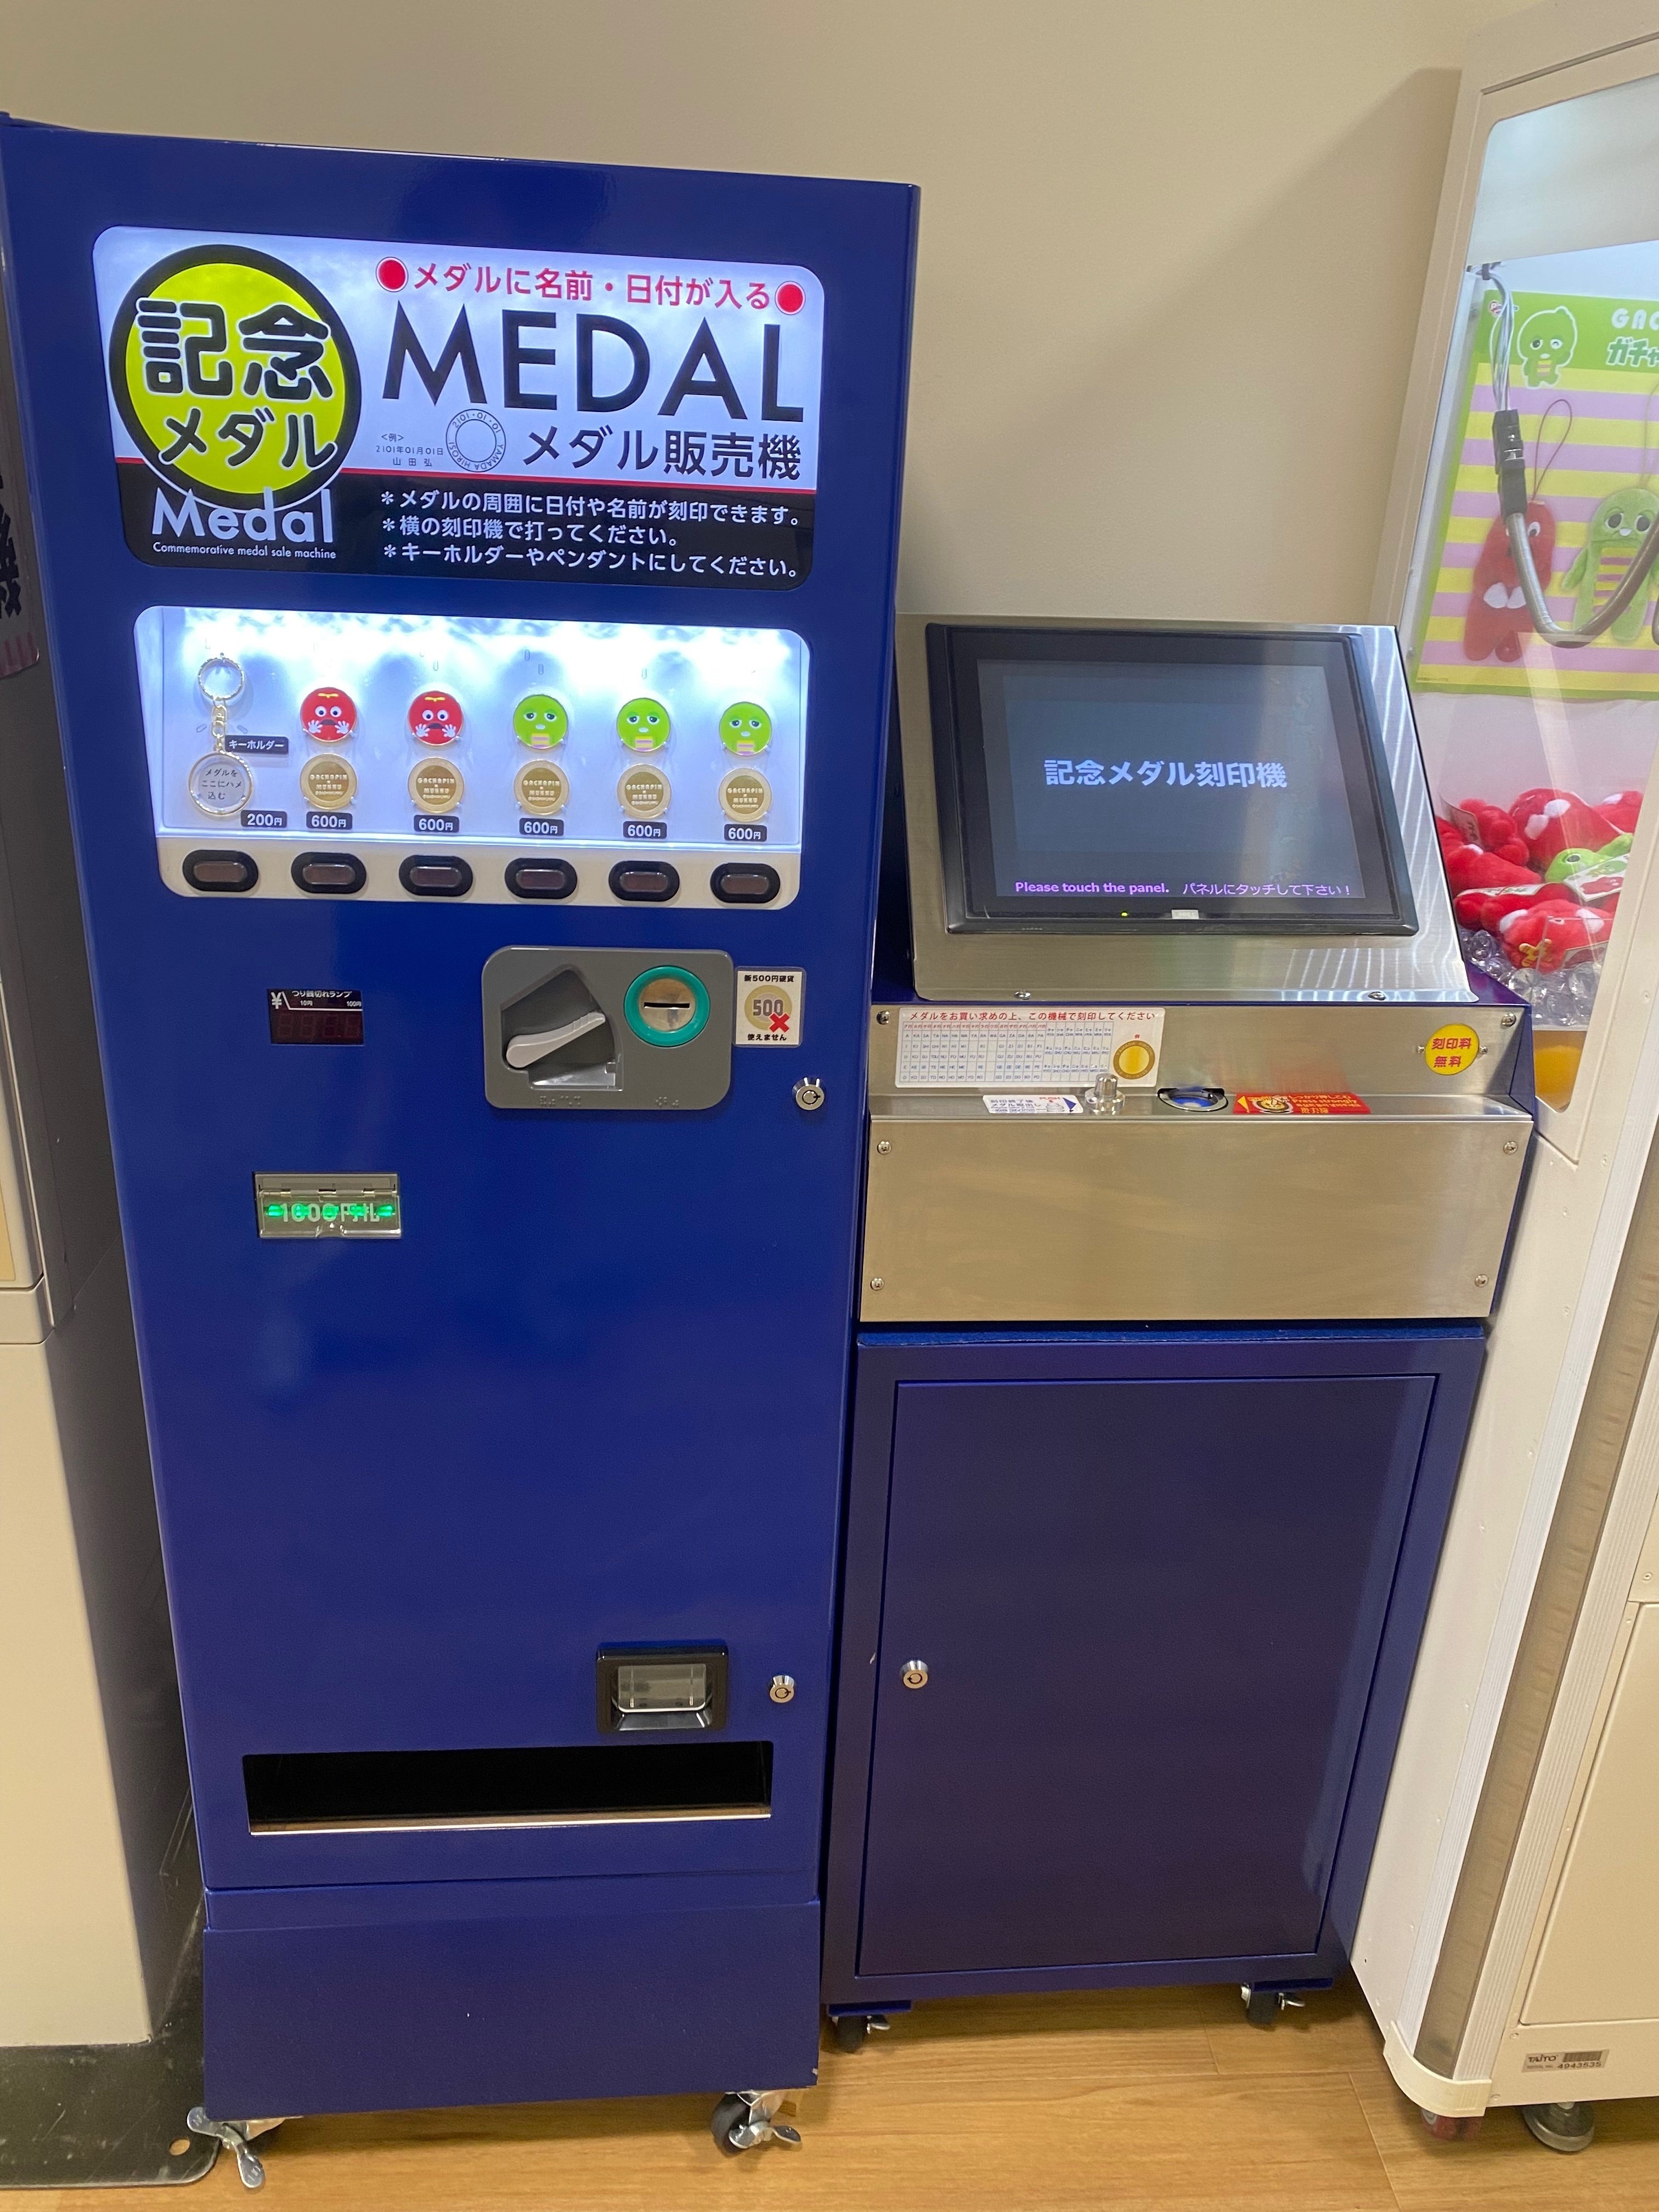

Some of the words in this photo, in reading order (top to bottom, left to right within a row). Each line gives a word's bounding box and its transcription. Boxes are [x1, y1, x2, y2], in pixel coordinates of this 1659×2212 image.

[137, 298, 334, 401] 記念
[382, 300, 804, 424] MEDAL
[160, 407, 336, 469] メダル
[376, 445, 443, 455] 2101年01月01日
[522, 425, 802, 480] メダル販売機
[474, 444, 504, 470] YAMADA
[151, 487, 334, 543] Medal
[153, 541, 234, 556] Commemorative
[236, 545, 268, 557] medal
[271, 546, 292, 558] sale
[294, 547, 336, 559] machine
[228, 740, 284, 750] キーホルダー
[205, 768, 238, 777] メダルを
[1043, 759, 1288, 789] 記念メダル刻印機
[247, 813, 283, 827] 200円
[311, 815, 347, 828] 600円
[419, 818, 453, 831] 600円
[524, 821, 558, 834] 600円
[628, 825, 661, 837] 600円
[728, 828, 761, 840] 600円
[1015, 882, 1059, 894] Please
[1062, 882, 1100, 894] touch
[1104, 882, 1125, 894] the
[1128, 883, 1170, 895] panel.
[753, 1000, 783, 1016] 500
[1431, 1037, 1471, 1049] 刻印料
[1434, 1056, 1462, 1068] 無料
[1528, 2054, 1556, 2062] TAITO
